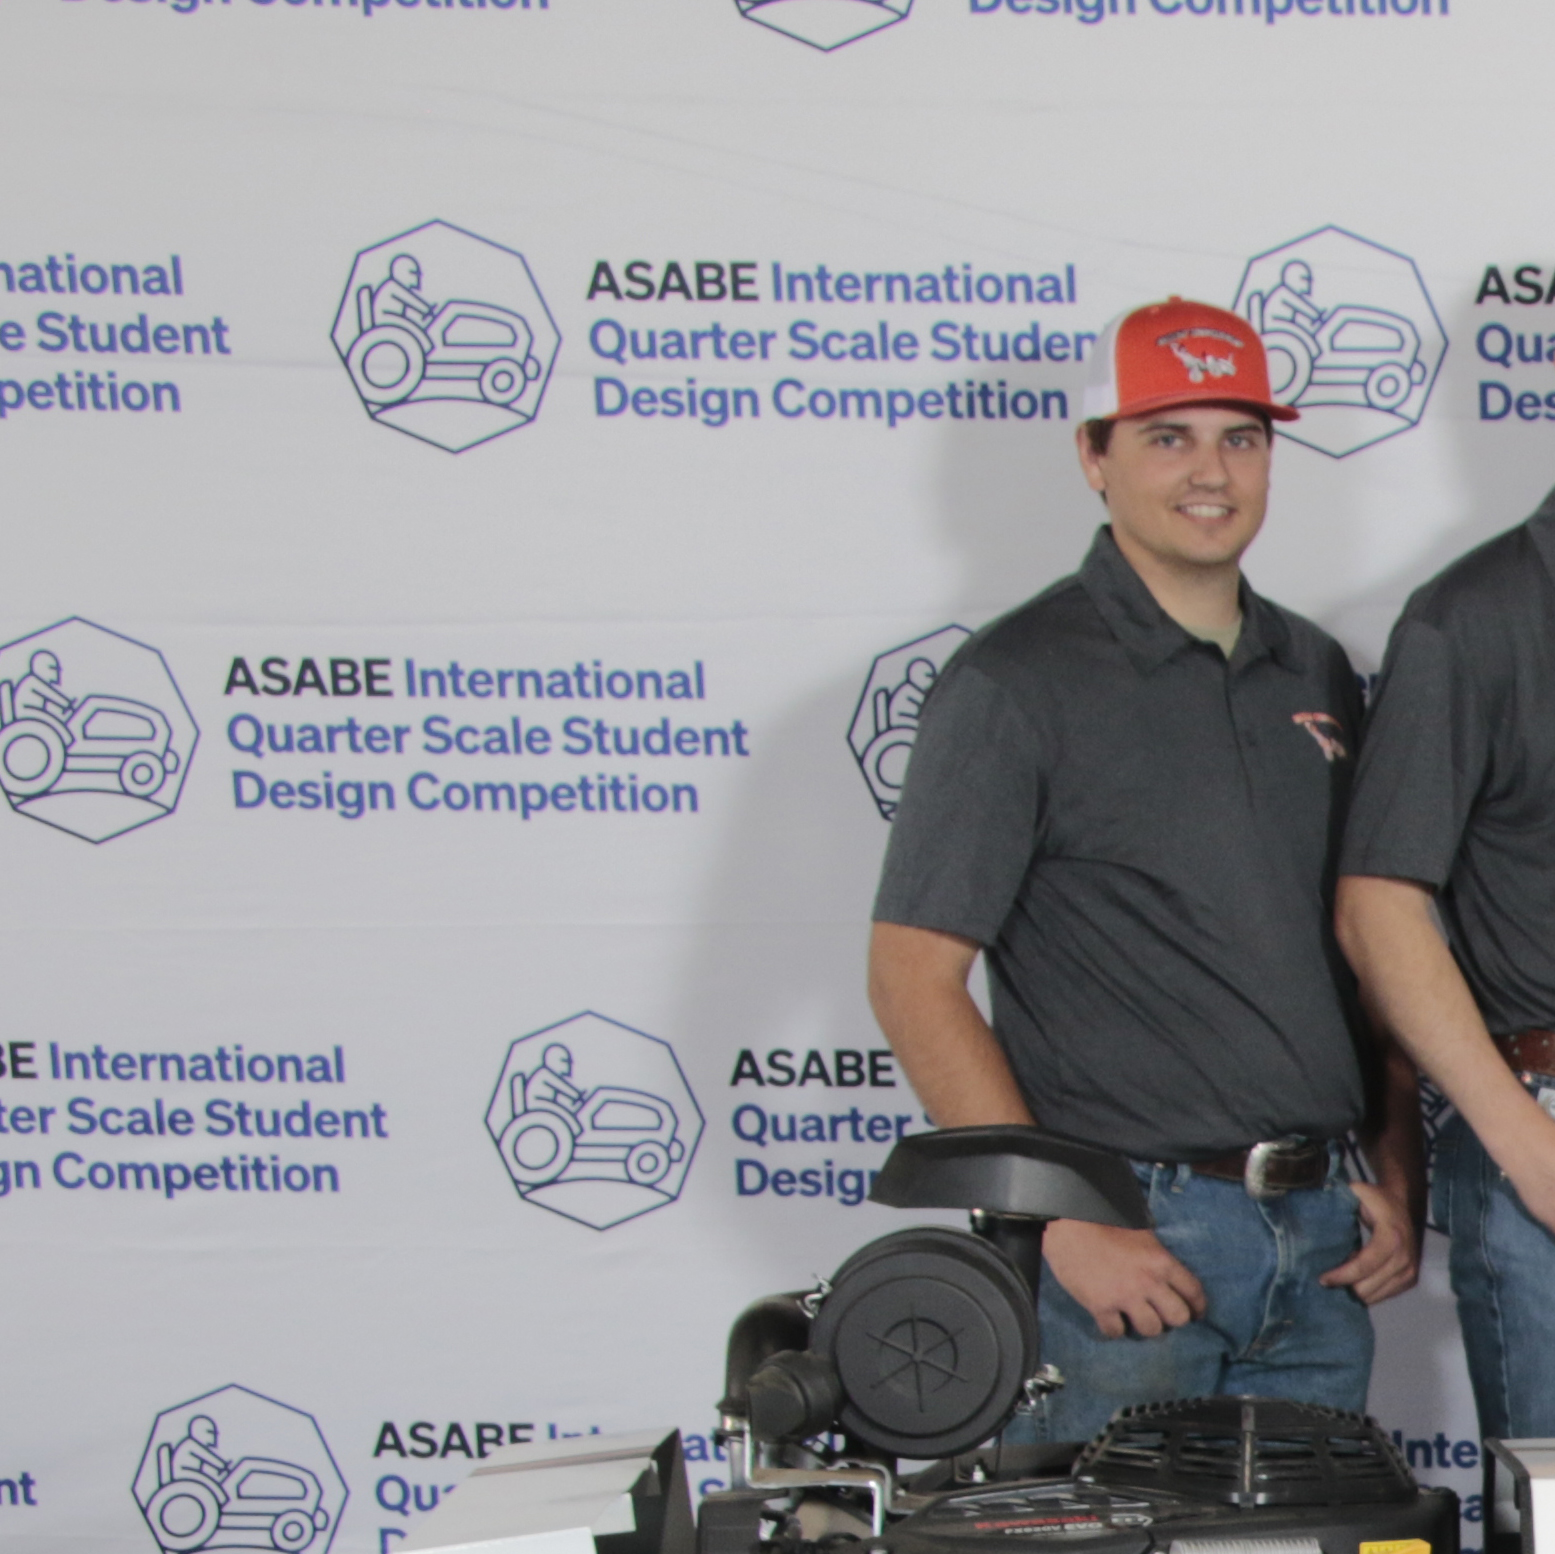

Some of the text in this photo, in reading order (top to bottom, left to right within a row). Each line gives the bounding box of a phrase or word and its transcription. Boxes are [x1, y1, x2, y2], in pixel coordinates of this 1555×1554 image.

[0, 253, 183, 295] national
[586, 260, 1076, 304] ASABE International
[37, 311, 231, 354] Student
[589, 318, 1097, 365] Quarter Scale Studen
[0, 371, 180, 419] petition
[594, 377, 1068, 428] Design Competition
[224, 656, 705, 700] ASABE International
[227, 713, 749, 758] Quarter Scale Student
[232, 770, 698, 820] Design Competition
[49, 1042, 345, 1083] International
[731, 1050, 895, 1087] ASABE
[67, 1097, 195, 1136] Scale
[205, 1099, 388, 1138] Student
[731, 1105, 912, 1151] Quarter
[52, 1151, 339, 1199] Competition
[736, 1161, 877, 1206] Desig
